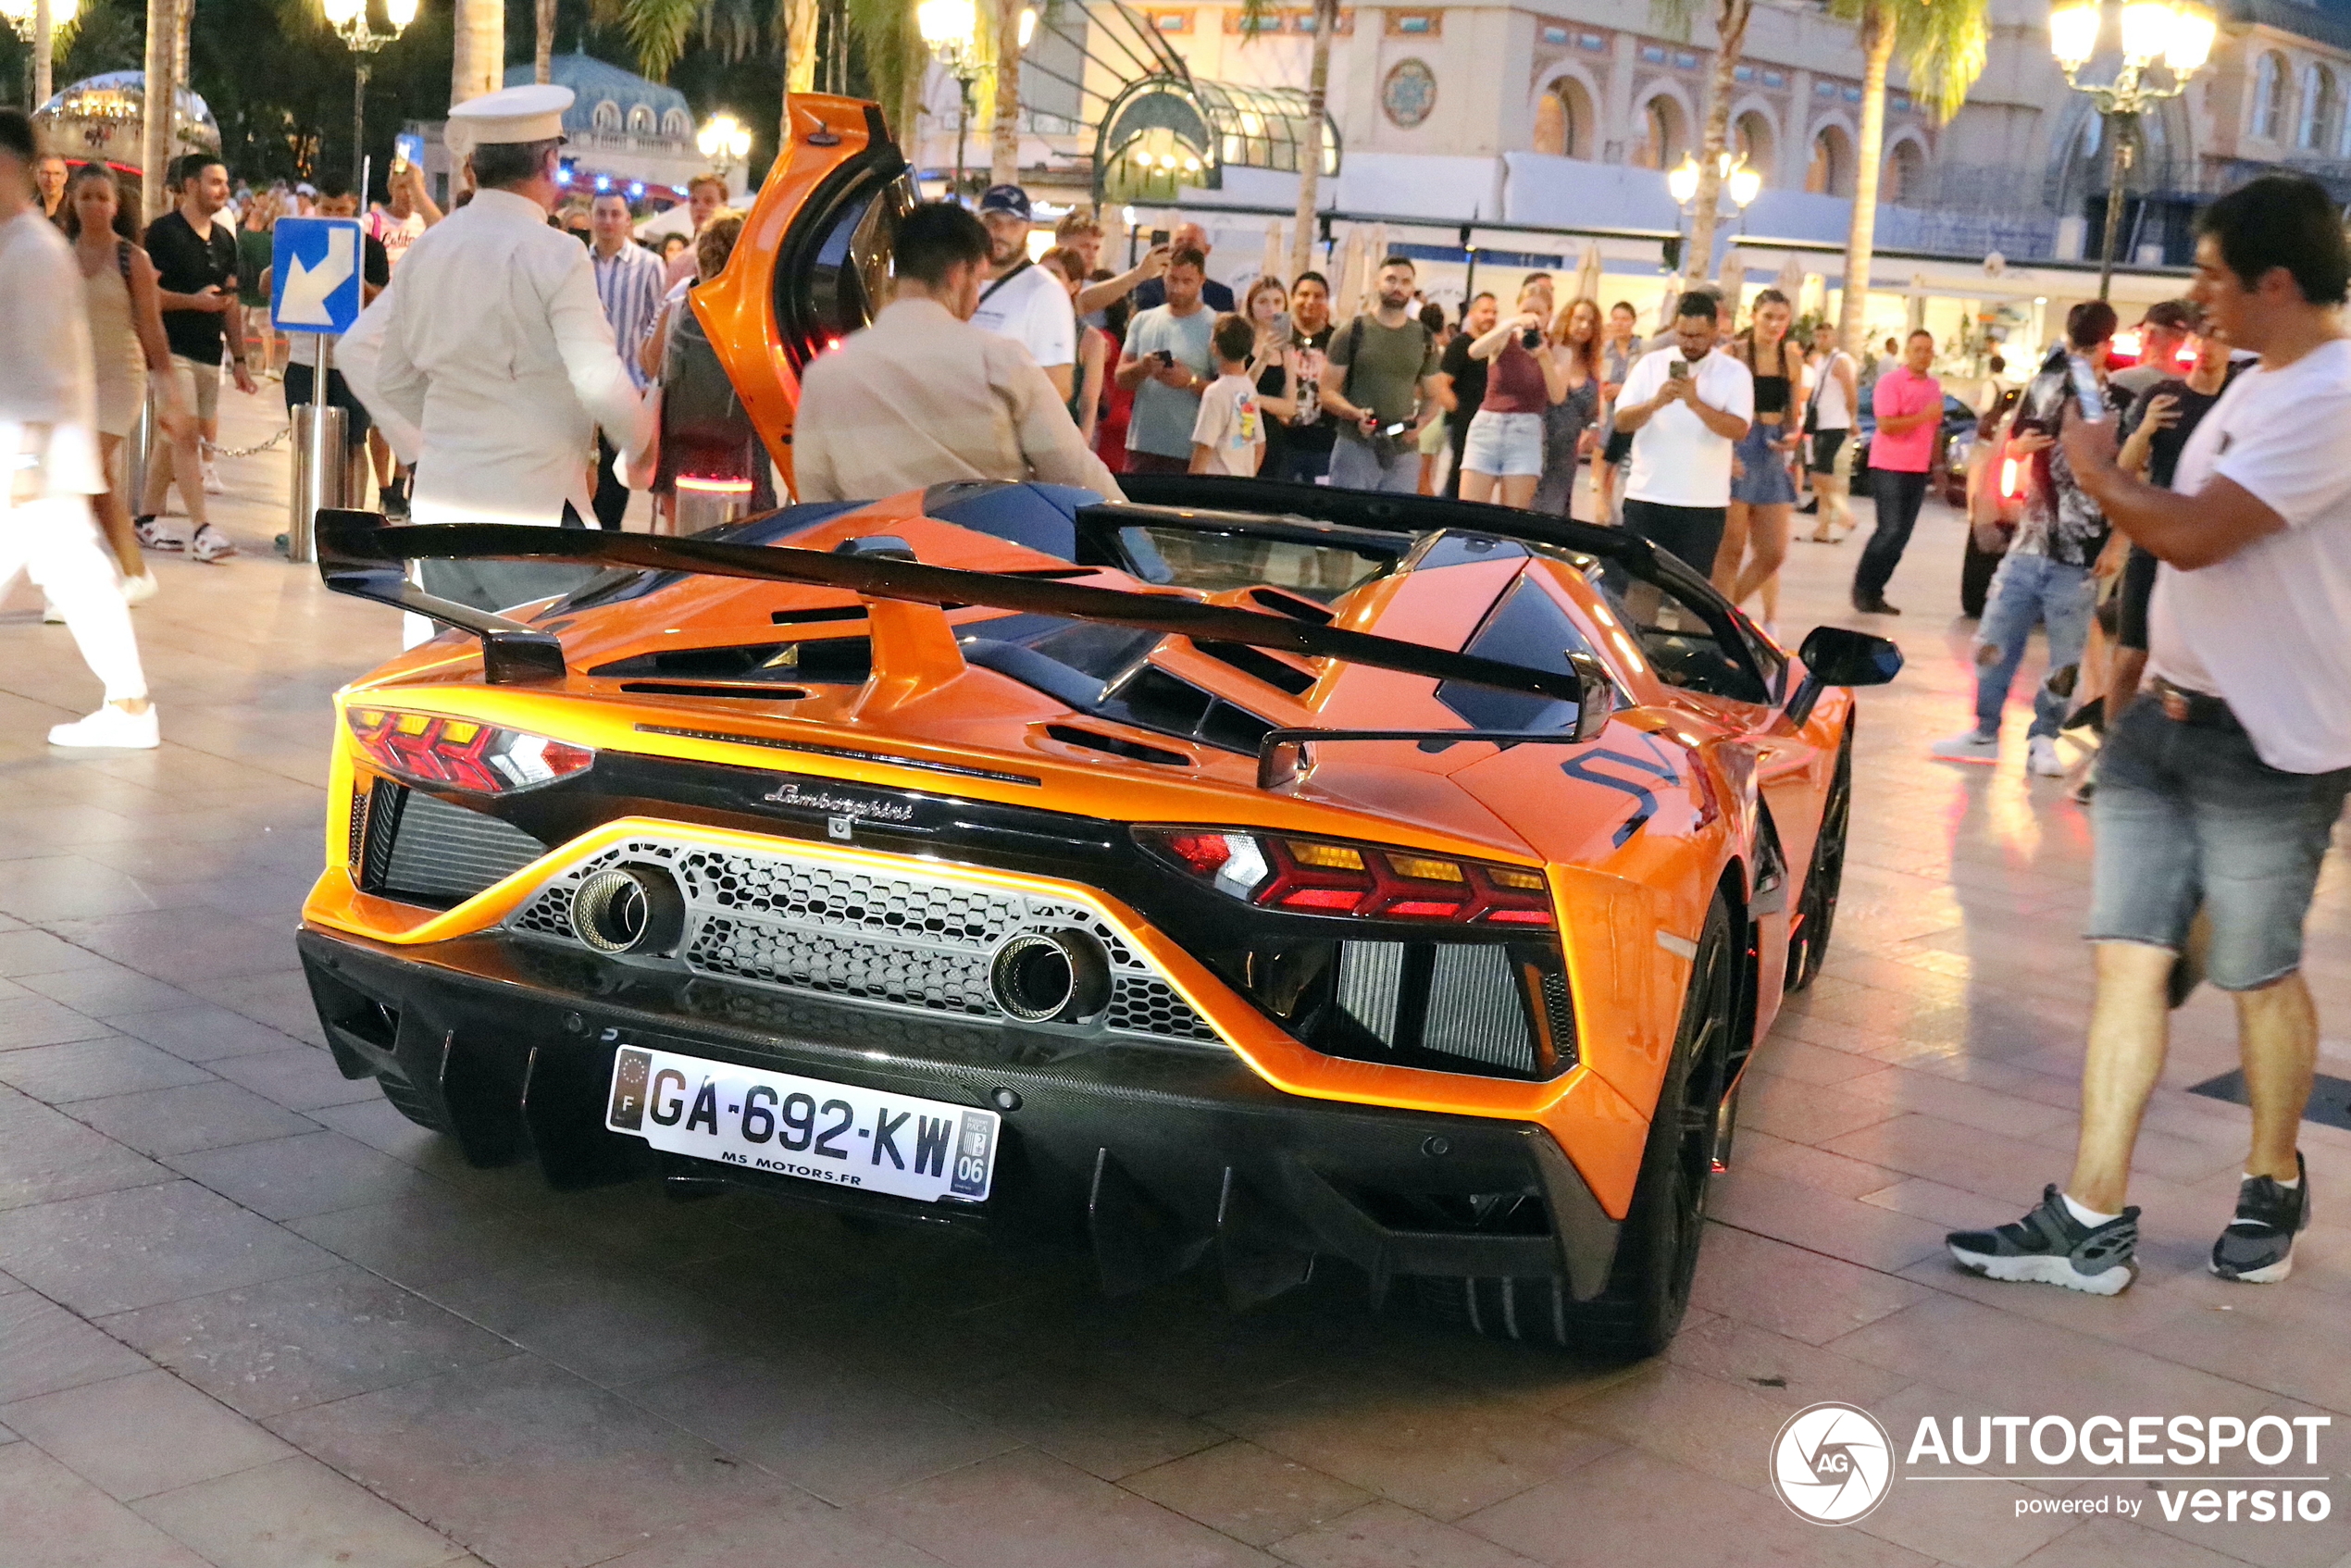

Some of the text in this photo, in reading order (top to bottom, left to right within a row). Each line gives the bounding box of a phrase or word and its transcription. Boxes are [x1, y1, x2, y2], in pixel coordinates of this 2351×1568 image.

[765, 783, 913, 822] Lamborghini
[622, 1094, 635, 1111] F
[650, 1069, 952, 1177] GA-692-KW
[966, 1123, 988, 1133] PACA
[721, 1151, 862, 1186] MS MOTORS.FR
[958, 1156, 984, 1183] 06
